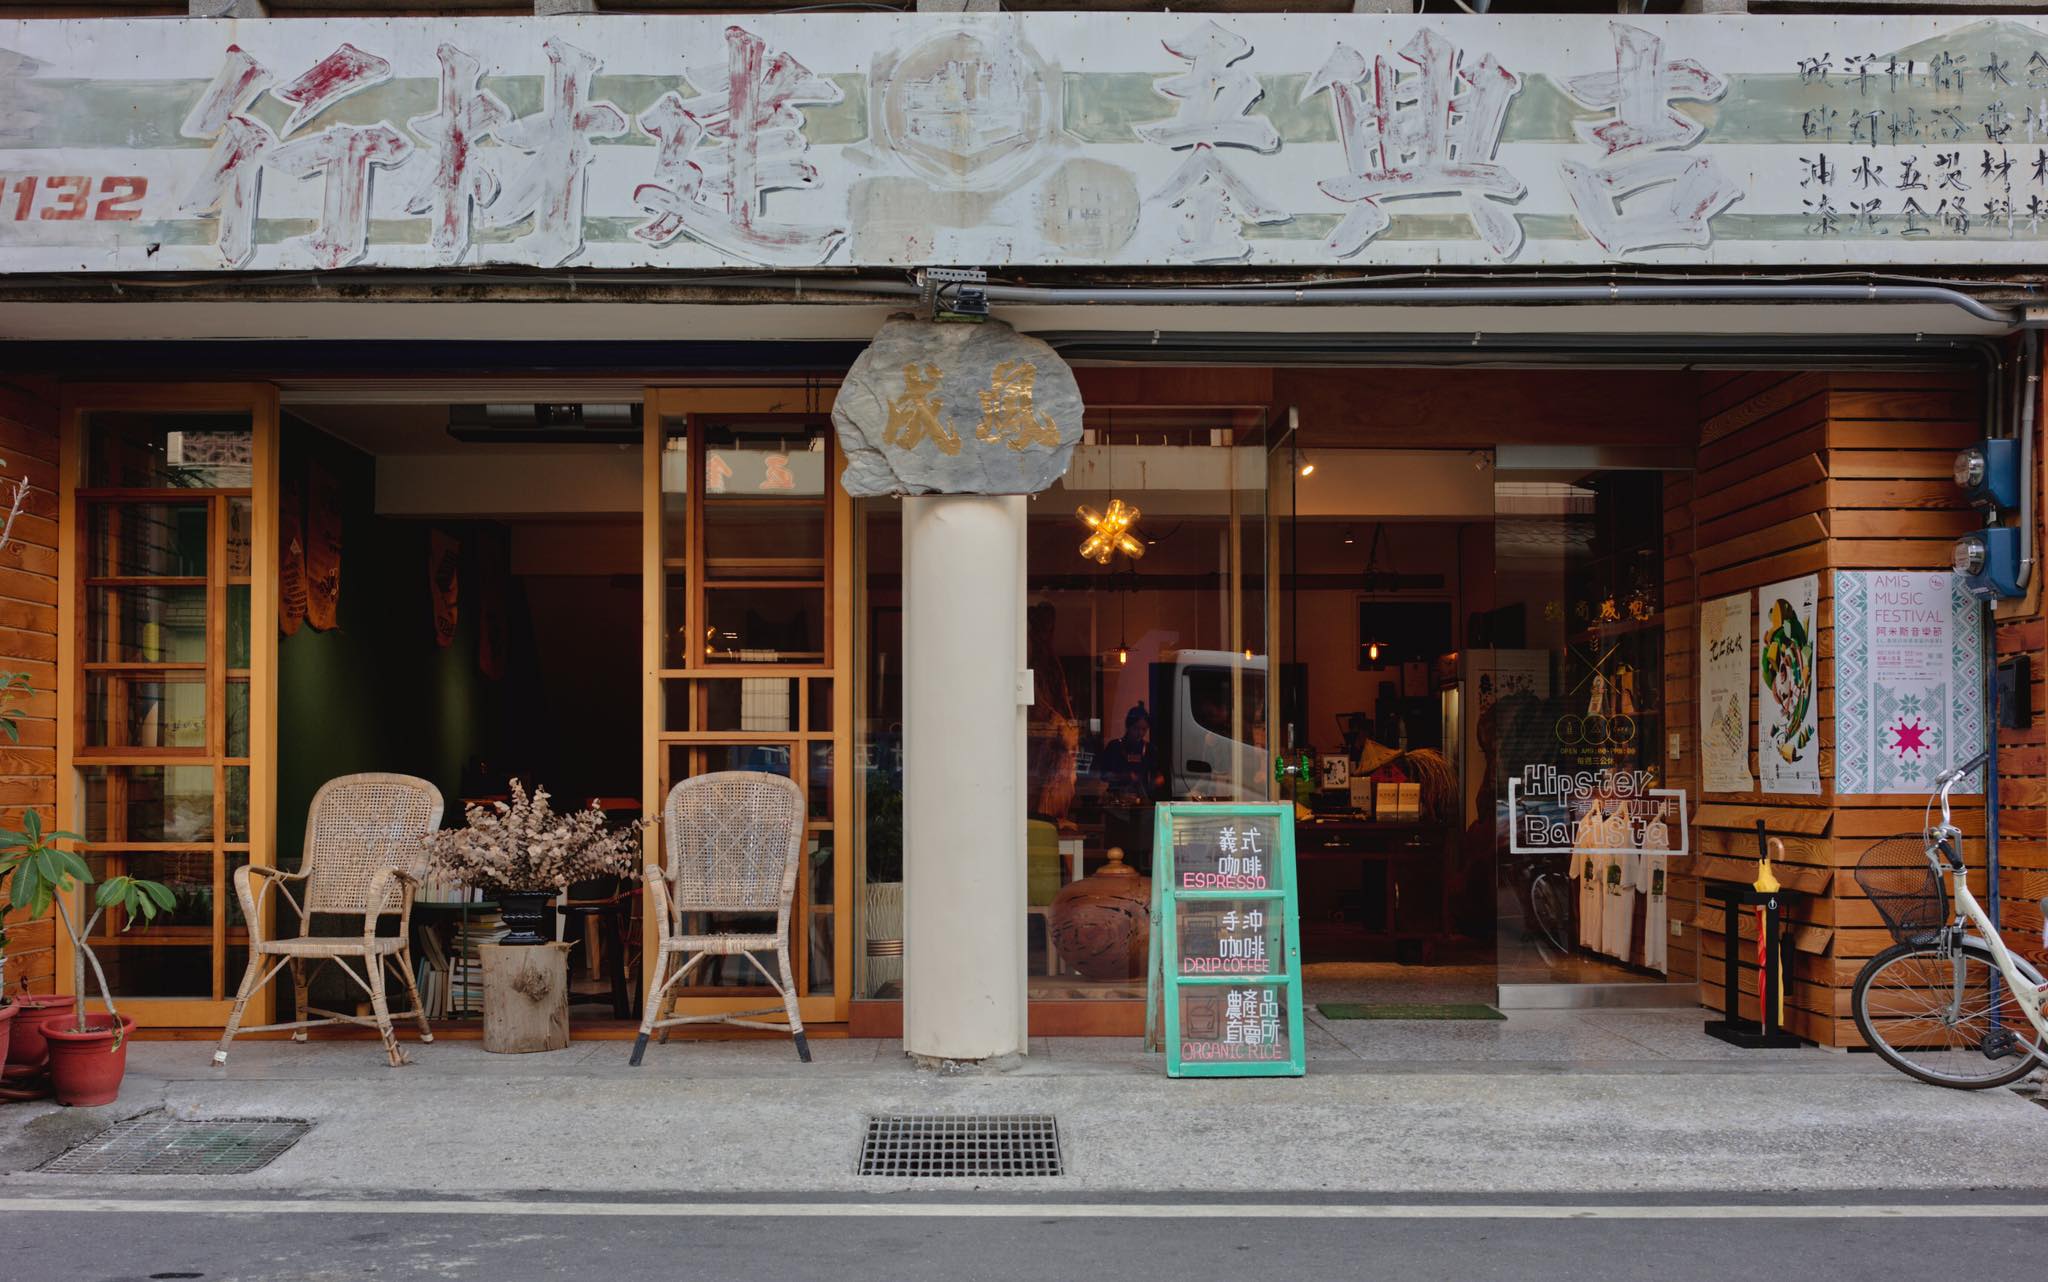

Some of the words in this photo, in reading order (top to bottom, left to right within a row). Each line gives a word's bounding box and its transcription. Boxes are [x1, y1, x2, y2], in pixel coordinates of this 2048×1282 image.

[0, 175, 149, 221] 132
[1875, 574, 1911, 588] AMIS
[1875, 592, 1924, 606] MUSIC
[1875, 608, 1944, 623] FESTIVAL
[1524, 764, 1653, 808] Hipster
[1219, 827, 1262, 853] 義式
[1525, 815, 1670, 847] Barista
[1218, 854, 1262, 878] 咖啡
[1183, 872, 1266, 890] ESPRESSO
[1222, 909, 1263, 933] 手沖
[1219, 935, 1265, 960] 咖啡
[1183, 957, 1221, 973] DRIP
[1223, 957, 1270, 973] COFFEE
[1225, 989, 1279, 1020] 農產品
[1223, 1019, 1280, 1046] 直賣所
[1181, 1042, 1243, 1060] ORGANIC
[1248, 1043, 1281, 1060] RICE
